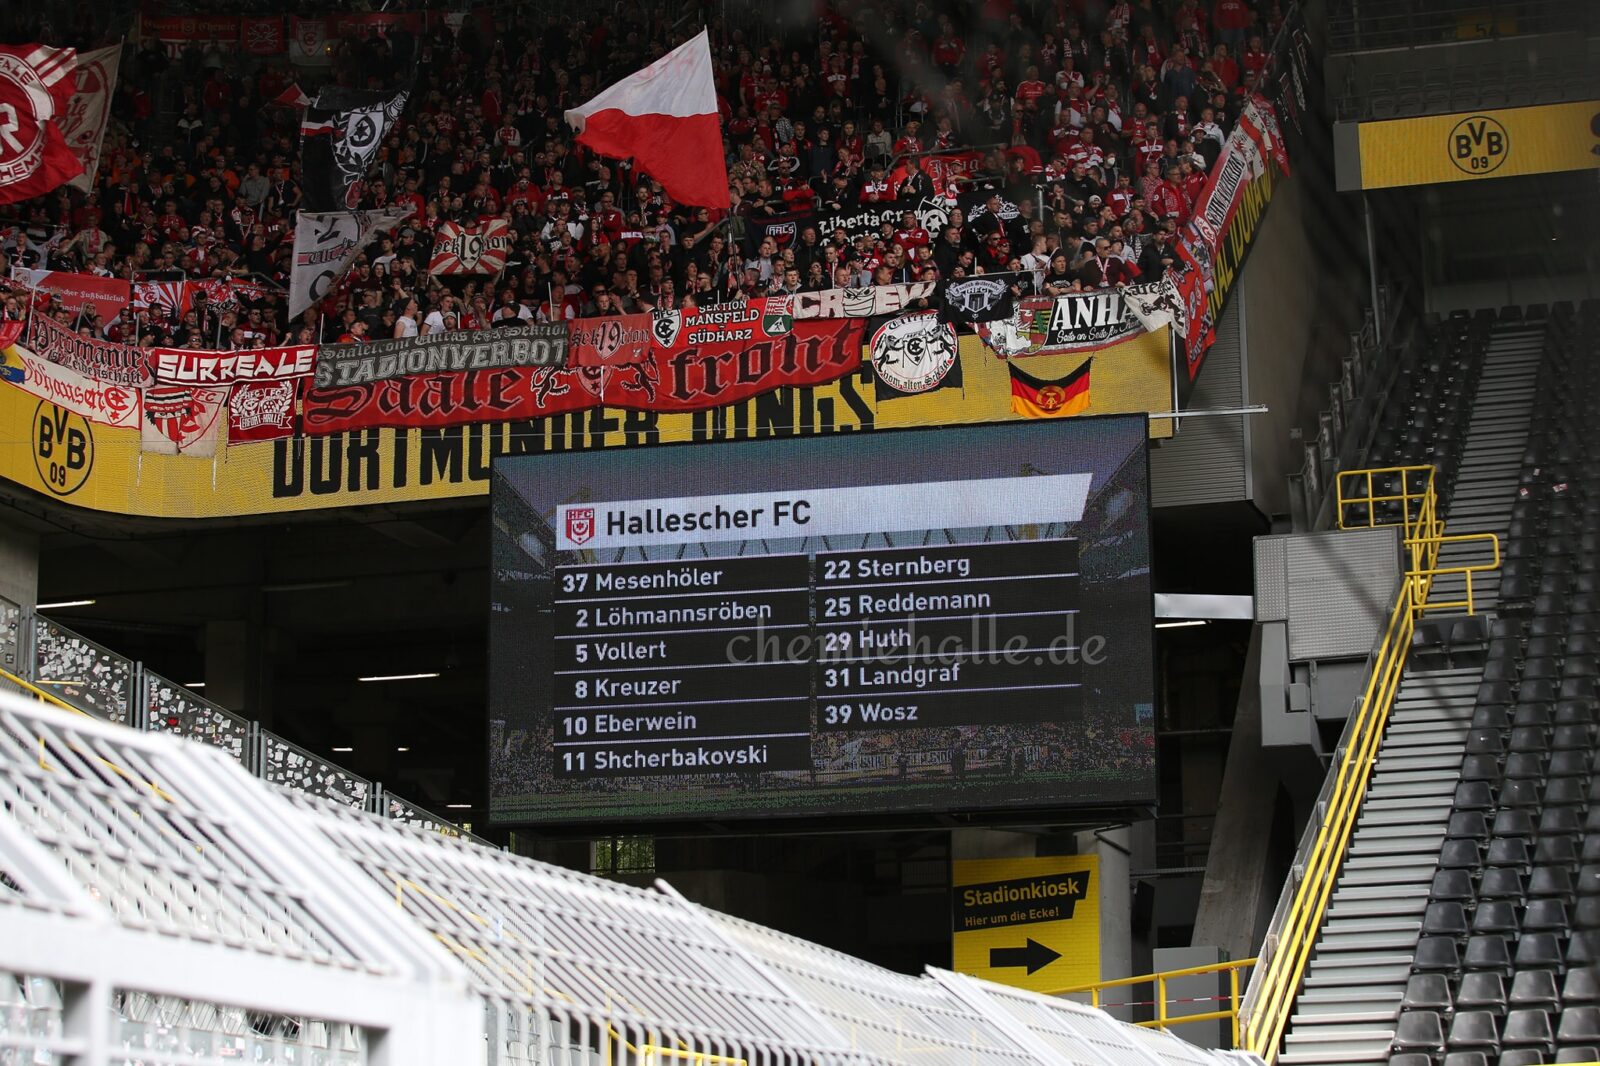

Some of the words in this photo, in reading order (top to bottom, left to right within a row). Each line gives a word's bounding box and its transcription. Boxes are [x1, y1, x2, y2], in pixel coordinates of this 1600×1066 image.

[1456, 122, 1504, 159] BVB
[1471, 157, 1489, 170] 09
[698, 300, 748, 312] SEKTION
[685, 310, 760, 328] MANSFELD
[688, 328, 752, 344] SÜDHARZ
[157, 349, 315, 382] SURREALE
[313, 337, 568, 389] STADIONVERBOT
[39, 402, 87, 470] BVB
[50, 462, 66, 487] 09
[606, 504, 764, 536] Hallescher
[773, 500, 811, 526] FC
[562, 573, 589, 592] 37
[595, 568, 723, 591] Mesenhöler
[824, 560, 851, 580] 22
[857, 556, 971, 578] Sternberg
[575, 609, 588, 628] 2
[595, 602, 772, 627] Löhmannsröben
[824, 597, 851, 617] 25
[858, 592, 991, 614] Reddemann
[575, 644, 588, 663] 5
[594, 640, 667, 661] Vollert
[824, 632, 851, 652] 29
[858, 628, 911, 649] Huth
[575, 680, 588, 699] 8
[595, 677, 682, 698] Kreuzer
[824, 669, 850, 688] 31
[858, 663, 960, 688] Landgraf
[563, 717, 588, 736] 10
[595, 711, 697, 733] Eberwein
[824, 705, 852, 724] 39
[859, 702, 919, 723] Wosz
[563, 752, 586, 771] 11
[594, 745, 767, 770] Shcherbakovski
[963, 877, 1080, 907] Stadionkiosk
[965, 916, 987, 927] Hier
[991, 914, 1008, 924] um
[1010, 911, 1027, 922] die
[1029, 906, 1060, 920] Ecke!
